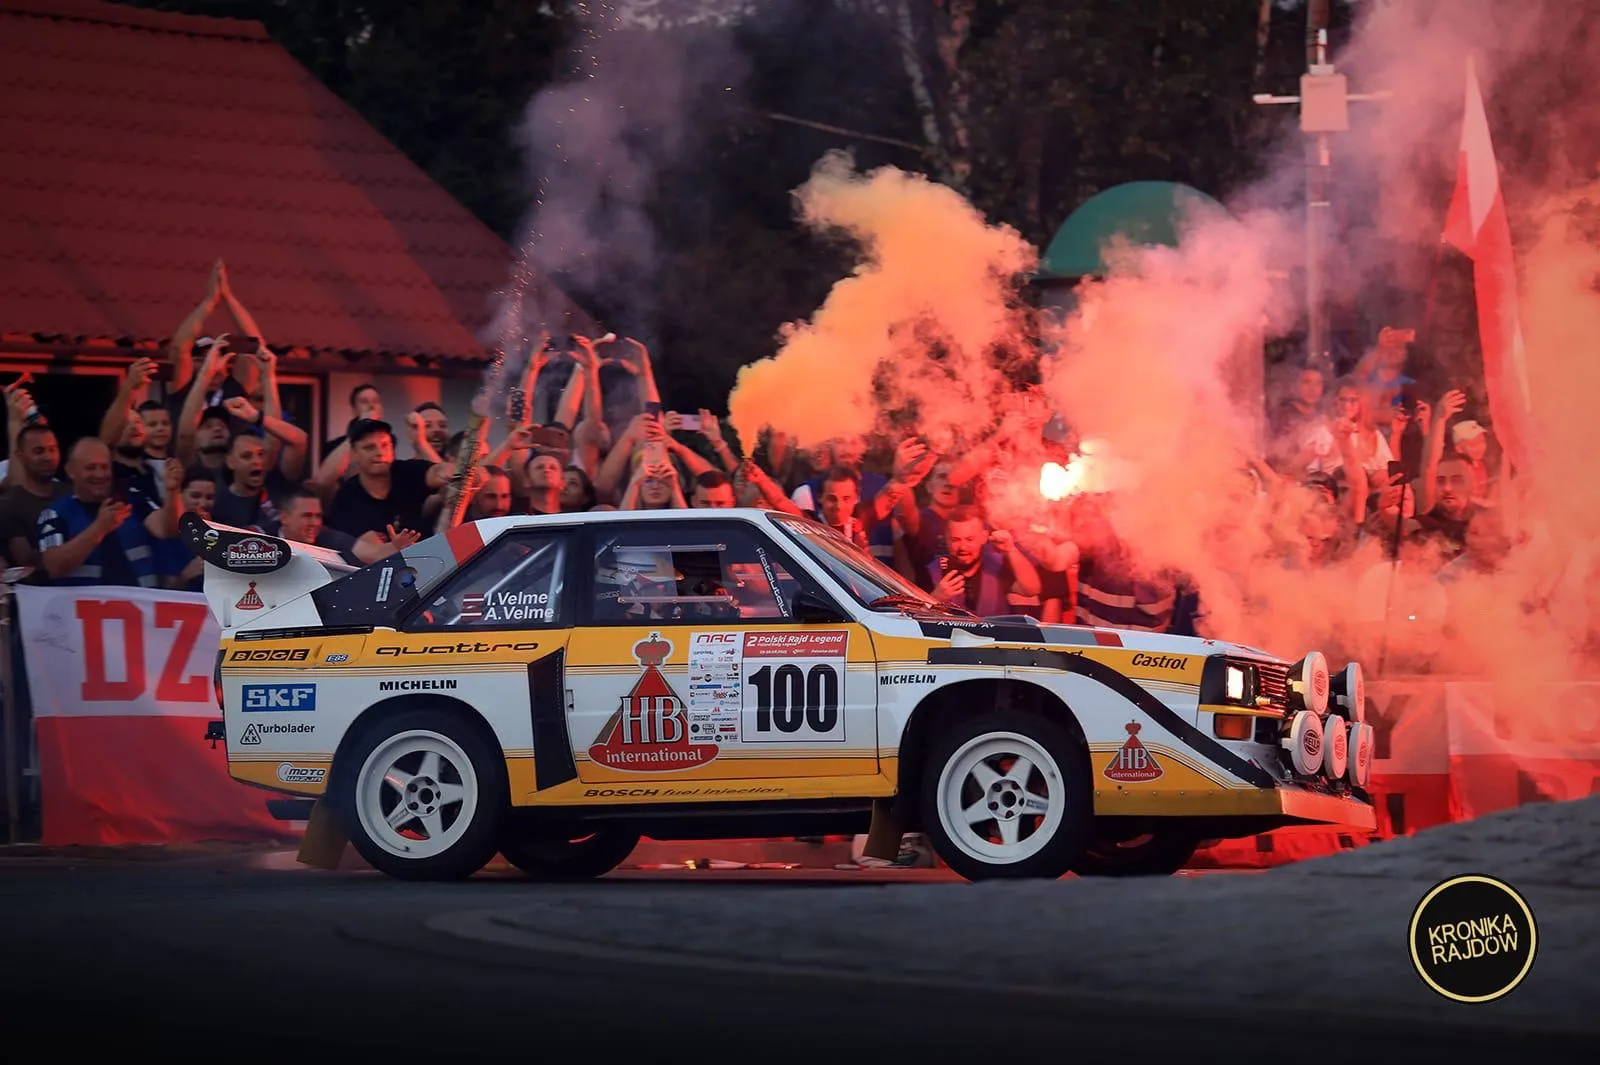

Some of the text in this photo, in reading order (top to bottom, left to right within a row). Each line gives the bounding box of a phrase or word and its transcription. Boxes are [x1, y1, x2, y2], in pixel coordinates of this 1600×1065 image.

[487, 592, 548, 605] I.Velme
[484, 607, 554, 620] A.Velme
[747, 635, 843, 647] 2 Polski Rajd Legend
[75, 599, 209, 702] DZ
[234, 651, 307, 660] BOGE
[376, 642, 539, 657] quattro
[1132, 653, 1188, 670] Castrol
[379, 679, 457, 690] MICHELIN
[879, 674, 937, 685] MICHELIN
[246, 688, 314, 707] SKF
[748, 664, 838, 732] 100
[620, 695, 684, 744] HB
[257, 723, 315, 733] Turbolader
[606, 748, 704, 763] international
[1119, 748, 1148, 769] HB
[288, 768, 326, 776] MOTO
[1111, 770, 1156, 778] international
[583, 787, 784, 797] BOSCH fuel injection
